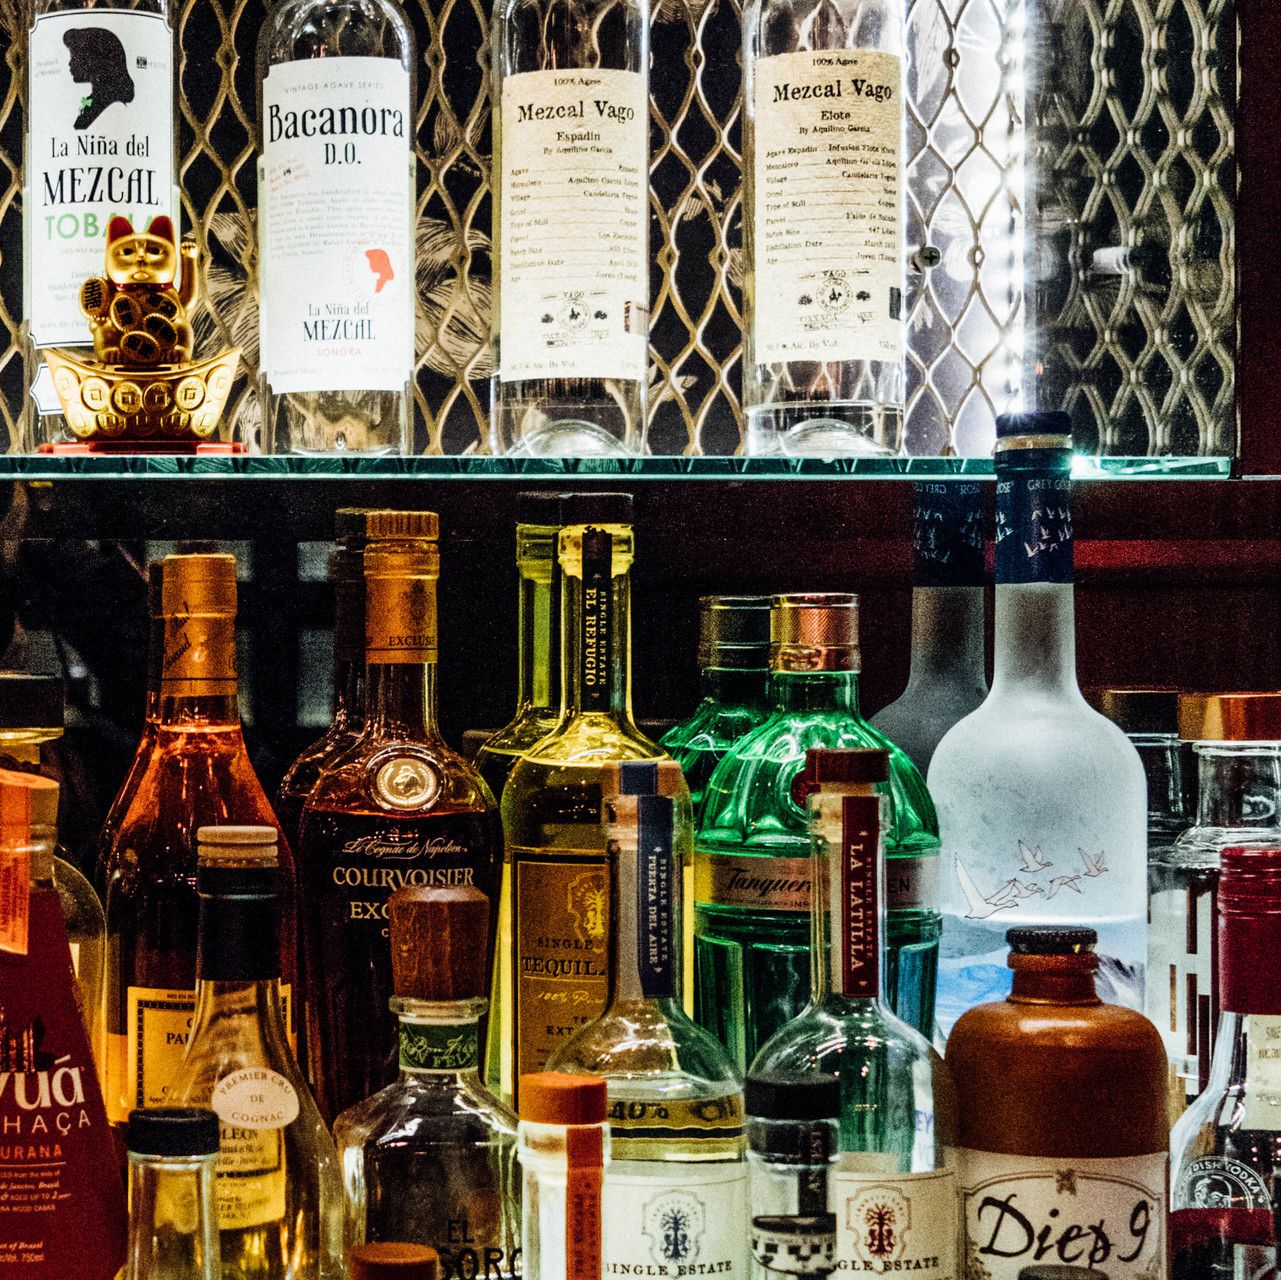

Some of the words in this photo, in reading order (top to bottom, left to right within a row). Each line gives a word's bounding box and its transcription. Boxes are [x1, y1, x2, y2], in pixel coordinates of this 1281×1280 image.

[812, 58, 834, 66] 100%
[835, 58, 858, 66] Agave
[284, 83, 319, 93] VINTAGE
[323, 81, 354, 90] AGAVE
[554, 77, 575, 86] 100%
[577, 77, 601, 86] Agave
[773, 80, 841, 103] Mezcal
[851, 79, 892, 103] Vago
[517, 101, 584, 123] Mezcal
[594, 100, 635, 124] Vago
[821, 110, 851, 121] Elote
[269, 103, 404, 143] Bacanora
[799, 126, 808, 135] By
[812, 125, 845, 134] Aquilino
[51, 138, 68, 158] La
[77, 134, 118, 157] Niña
[127, 135, 150, 158] del
[324, 143, 362, 165] D.O.
[543, 147, 553, 155] By
[43, 167, 159, 207] MEZCAL
[308, 304, 321, 317] La
[325, 302, 350, 316] Niña
[354, 302, 370, 315] del
[304, 320, 376, 342] MEZCAL
[318, 346, 361, 357] SONORA
[586, 588, 597, 609] EL
[585, 615, 597, 686] REFUGIO
[405, 842, 419, 854] de
[850, 844, 862, 870] LA
[333, 866, 474, 892] COURVOISIER
[726, 868, 811, 897] Tanquer
[850, 881, 863, 970] LATILLA
[537, 937, 593, 950] SINGLE
[522, 956, 606, 977] TEQUIL
[220, 1071, 269, 1094] PREMIER
[271, 1074, 293, 1094] CRU
[250, 1094, 265, 1103] DE
[231, 1111, 284, 1122] COGNAC
[1223, 1161, 1263, 1193] VODKA
[447, 1220, 476, 1243] EL
[1117, 1200, 1151, 1262] 9
[607, 1263, 668, 1276] INGLE
[678, 1260, 732, 1276] ESTATE
[884, 1256, 939, 1270] ESTATE
